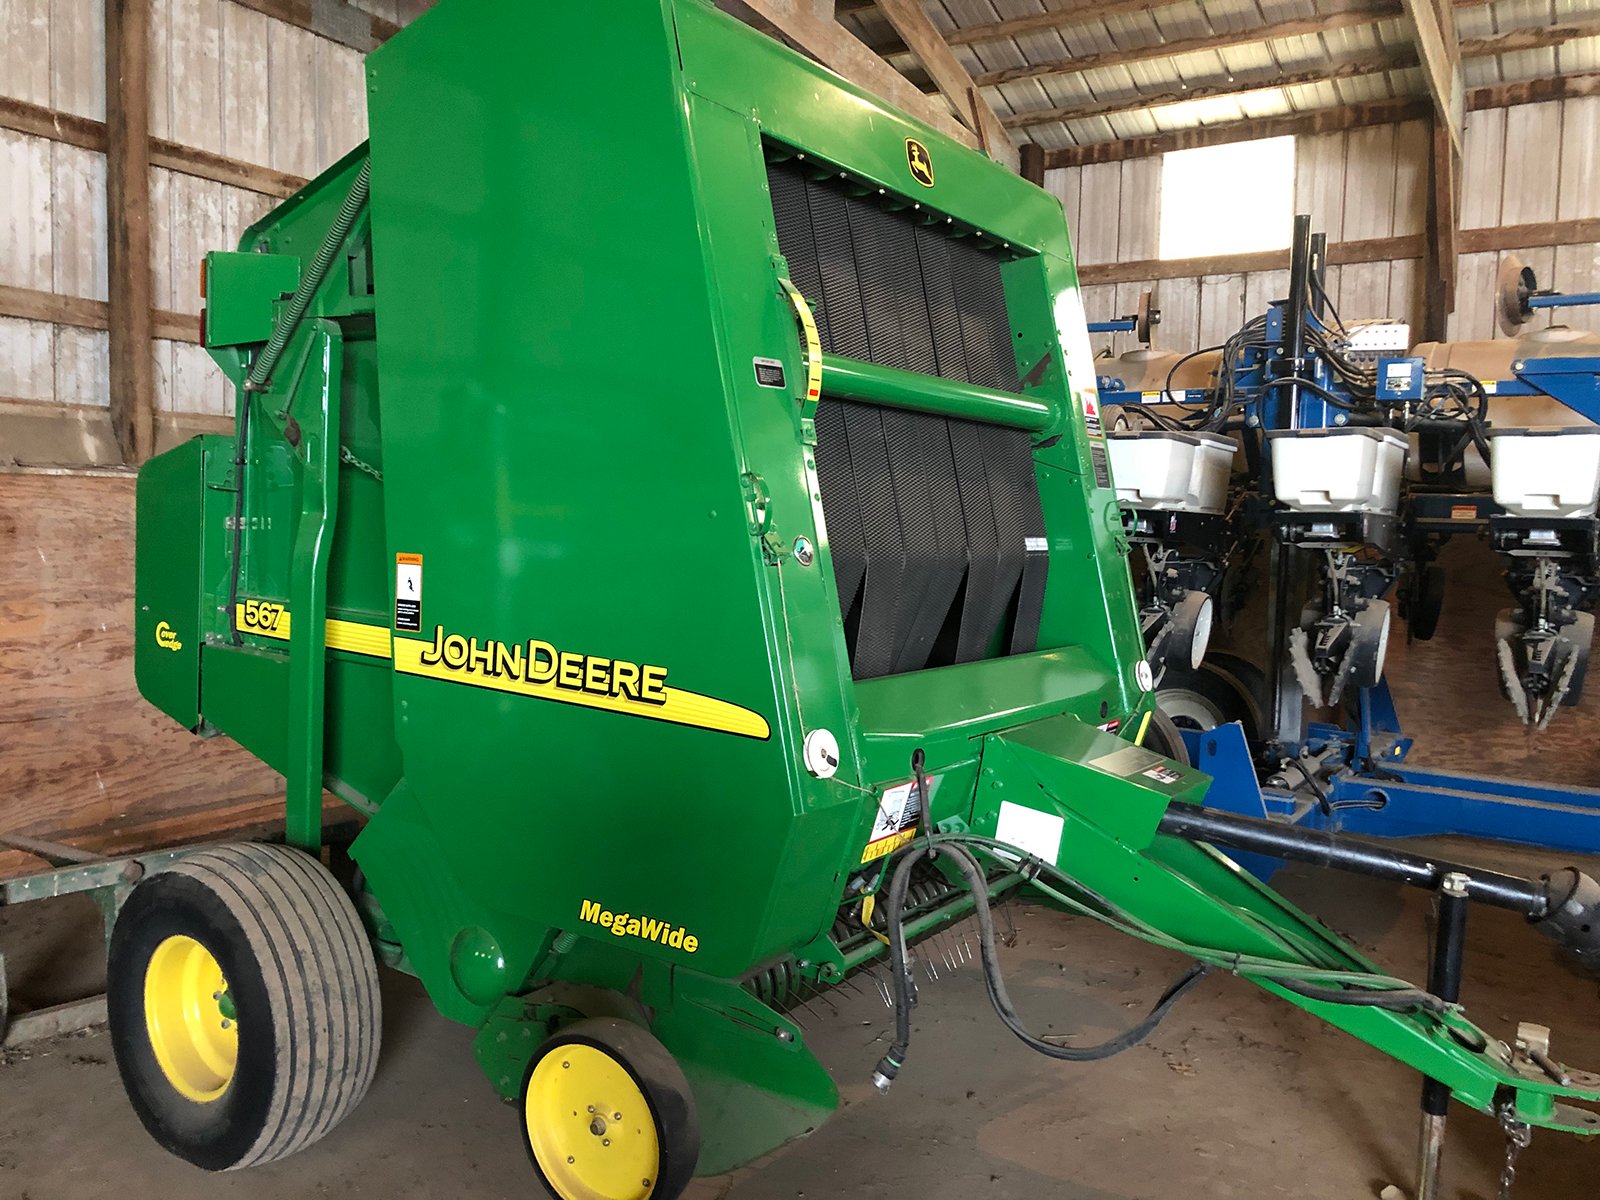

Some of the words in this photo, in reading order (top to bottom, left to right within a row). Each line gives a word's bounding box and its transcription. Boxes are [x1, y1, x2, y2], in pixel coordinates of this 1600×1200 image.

[245, 599, 284, 631] 567
[420, 625, 522, 681] JOHN
[525, 639, 668, 707] DEERE
[579, 899, 699, 953] MegaWide
